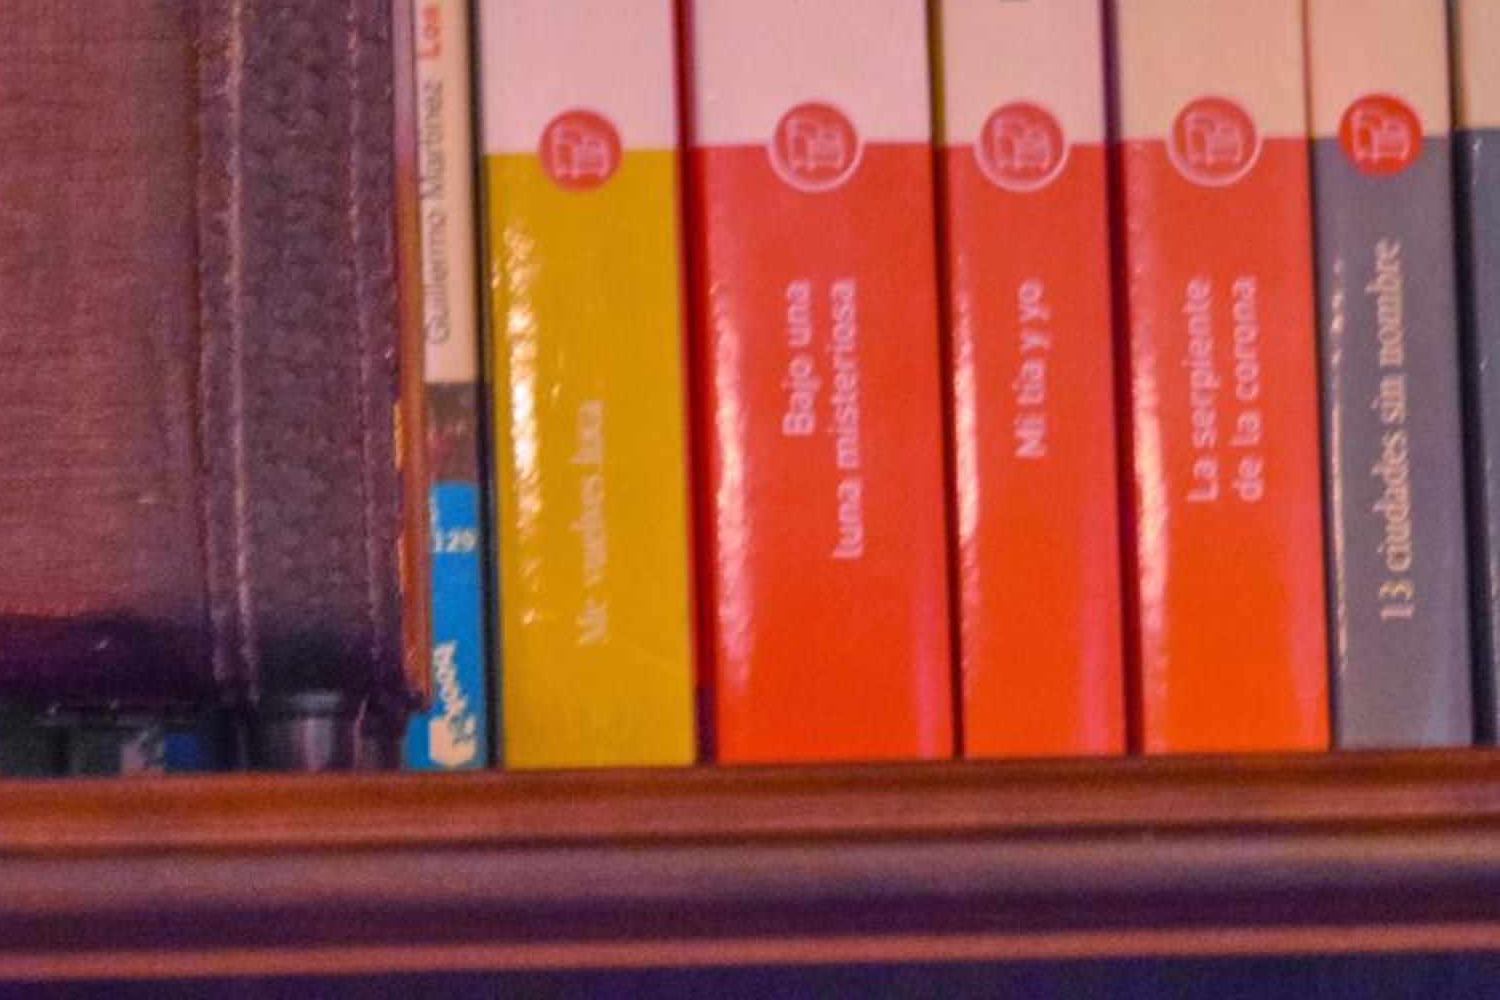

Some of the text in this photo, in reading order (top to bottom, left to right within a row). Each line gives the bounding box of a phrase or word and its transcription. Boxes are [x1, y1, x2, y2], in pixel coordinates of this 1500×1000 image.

[419, 6, 440, 60] Los
[422, 211, 451, 344] Guillermo
[1017, 324, 1052, 350] y
[1018, 280, 1050, 321] yo
[782, 281, 820, 436] Bajo una
[827, 280, 864, 560] luna misteriosa
[1182, 278, 1222, 502] La serpiente
[1231, 277, 1264, 502] de la corona
[1366, 237, 1412, 619] 13 ciudades sin nombre
[1015, 414, 1045, 459] Mi
